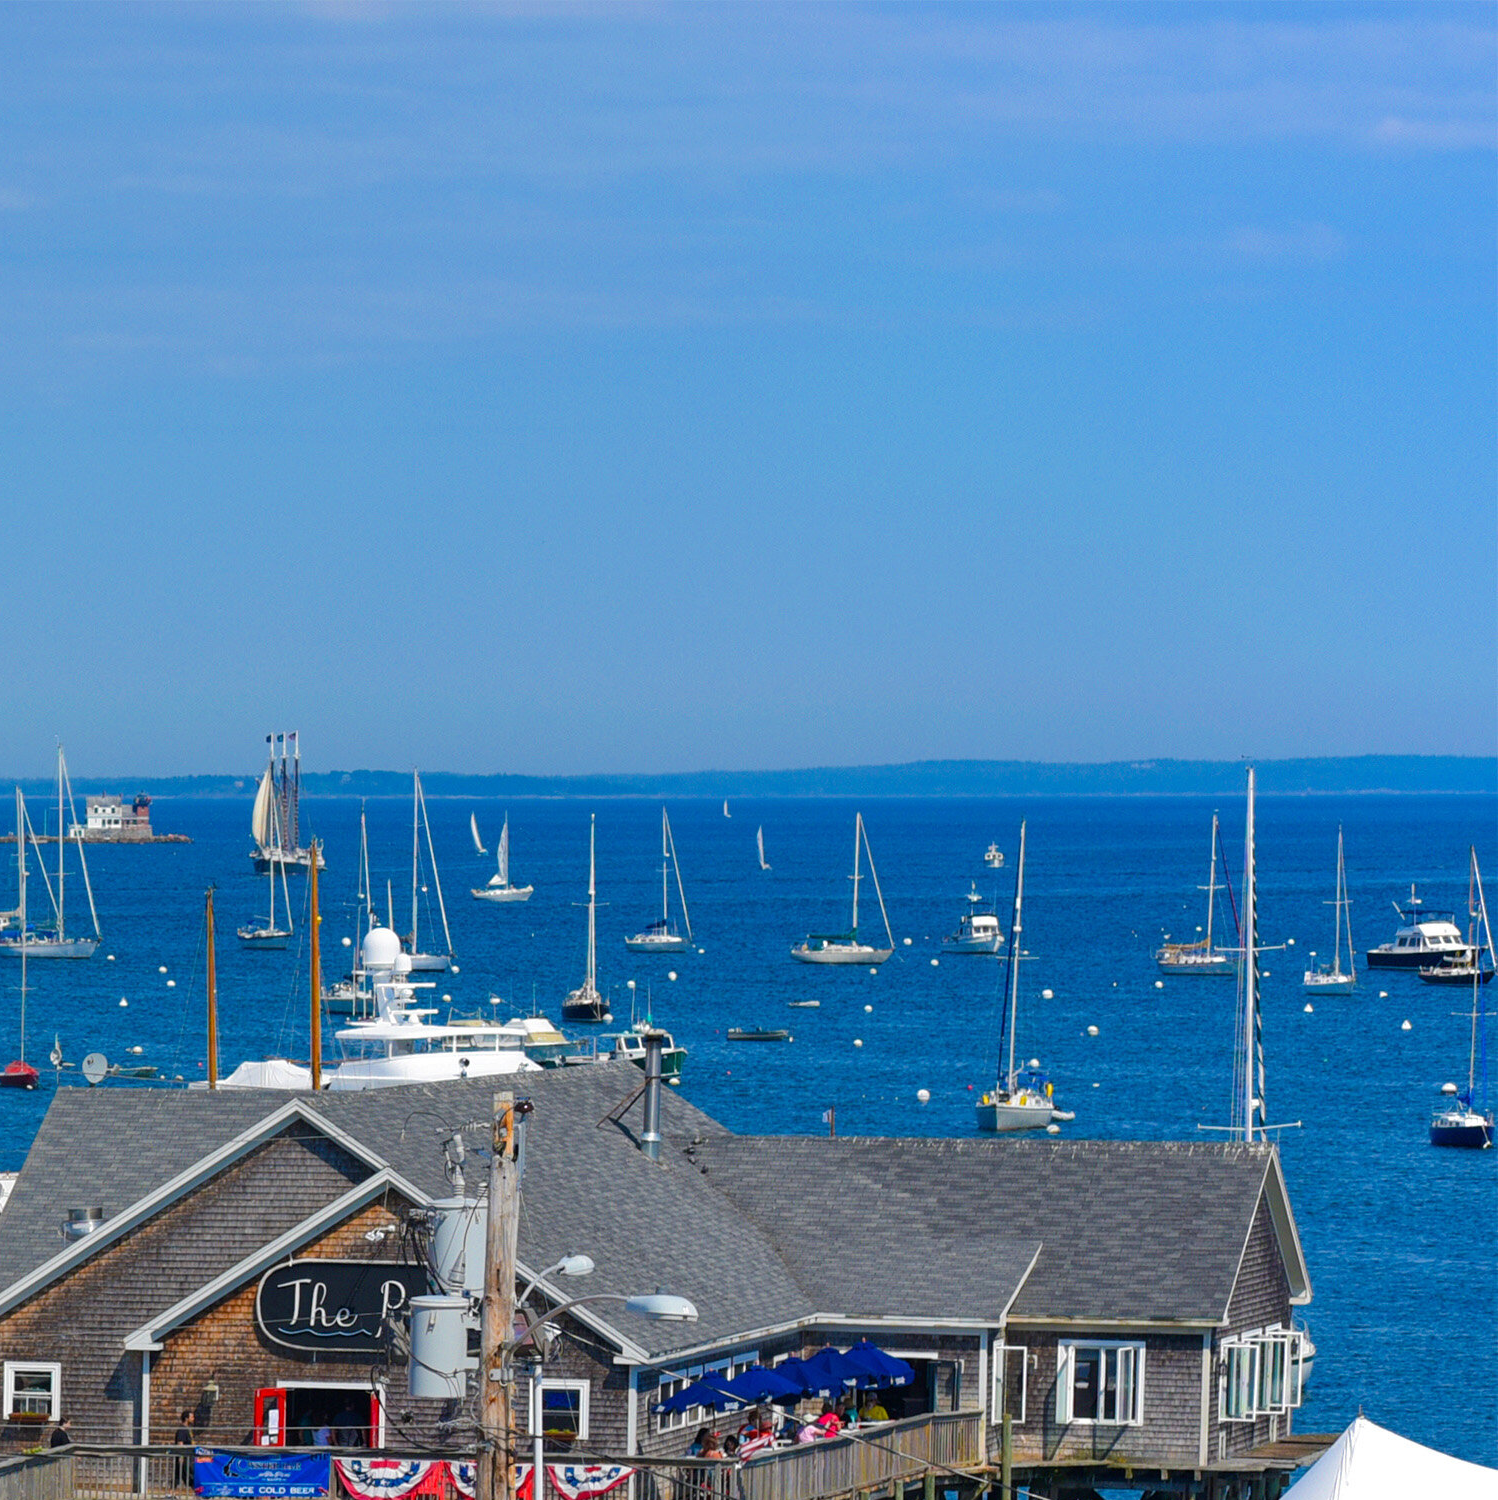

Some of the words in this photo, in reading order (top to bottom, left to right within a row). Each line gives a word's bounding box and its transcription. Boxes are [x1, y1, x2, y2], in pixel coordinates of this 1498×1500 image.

[277, 1278, 359, 1328] The
[238, 1486, 254, 1495] ICE
[259, 1486, 286, 1495] COLD
[290, 1486, 315, 1495] BEER
